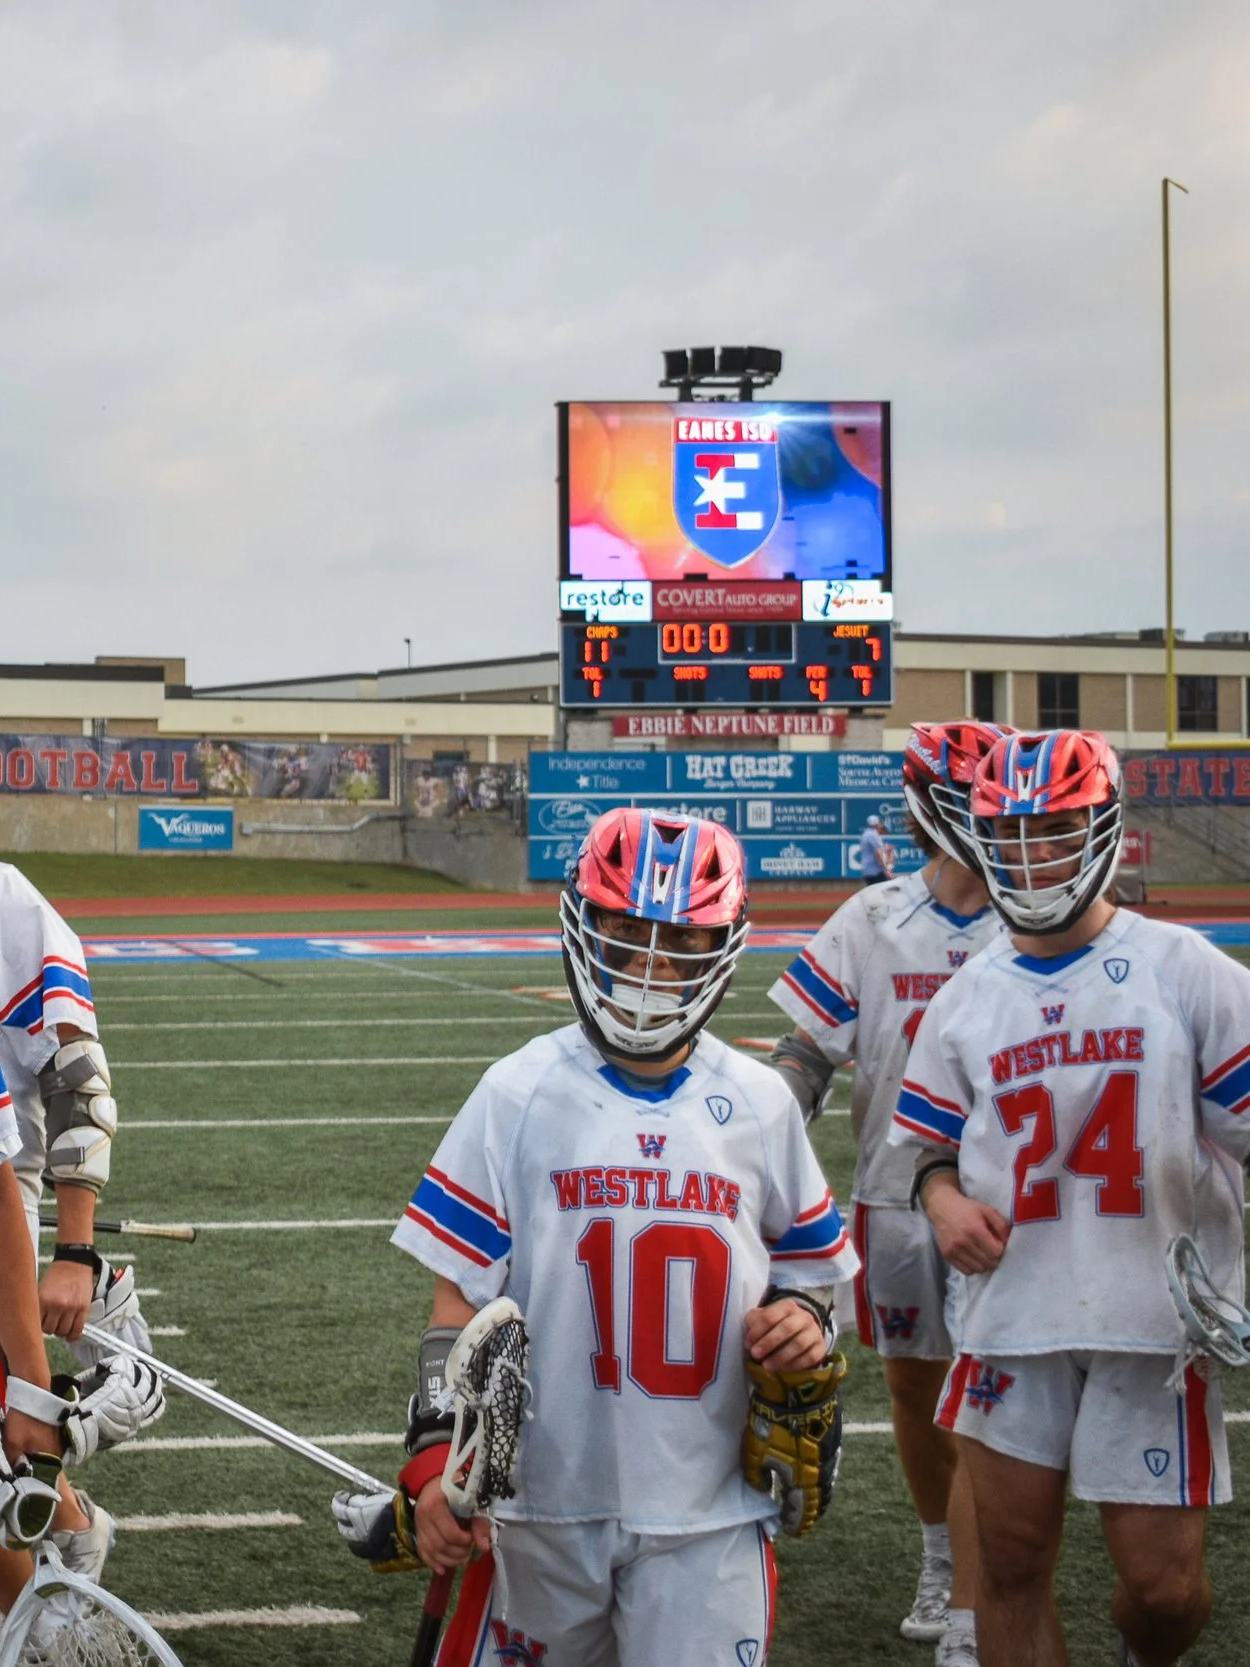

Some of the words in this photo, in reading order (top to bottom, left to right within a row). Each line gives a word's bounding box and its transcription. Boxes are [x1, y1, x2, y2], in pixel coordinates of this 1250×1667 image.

[678, 420, 736, 440] EANES
[741, 420, 772, 440] ISD
[567, 589, 644, 606] restore
[657, 588, 725, 606] COVERT
[725, 593, 756, 606] AUTO
[758, 593, 797, 606] GROUP
[586, 625, 619, 639] CHAPS
[833, 625, 870, 638] JESUIT
[865, 637, 882, 661] 7
[673, 666, 709, 680] SHOTS
[748, 665, 784, 679] SHOTS
[805, 665, 828, 679] PER
[809, 680, 827, 702] 4
[628, 716, 686, 736] EBBIE
[691, 716, 780, 735] NEPTUNE
[783, 715, 835, 734] FIELD
[548, 757, 646, 771] Independence
[685, 755, 726, 779] HAT
[730, 754, 794, 779] CREEK
[593, 775, 621, 789] Title
[1125, 757, 1250, 797] STATE
[148, 812, 226, 836] VAQUEROS
[988, 1026, 1144, 1086] WESTLAKE
[991, 1069, 1145, 1225] 24
[550, 1165, 742, 1223] WESTLAKE
[575, 1216, 732, 1401] 10
